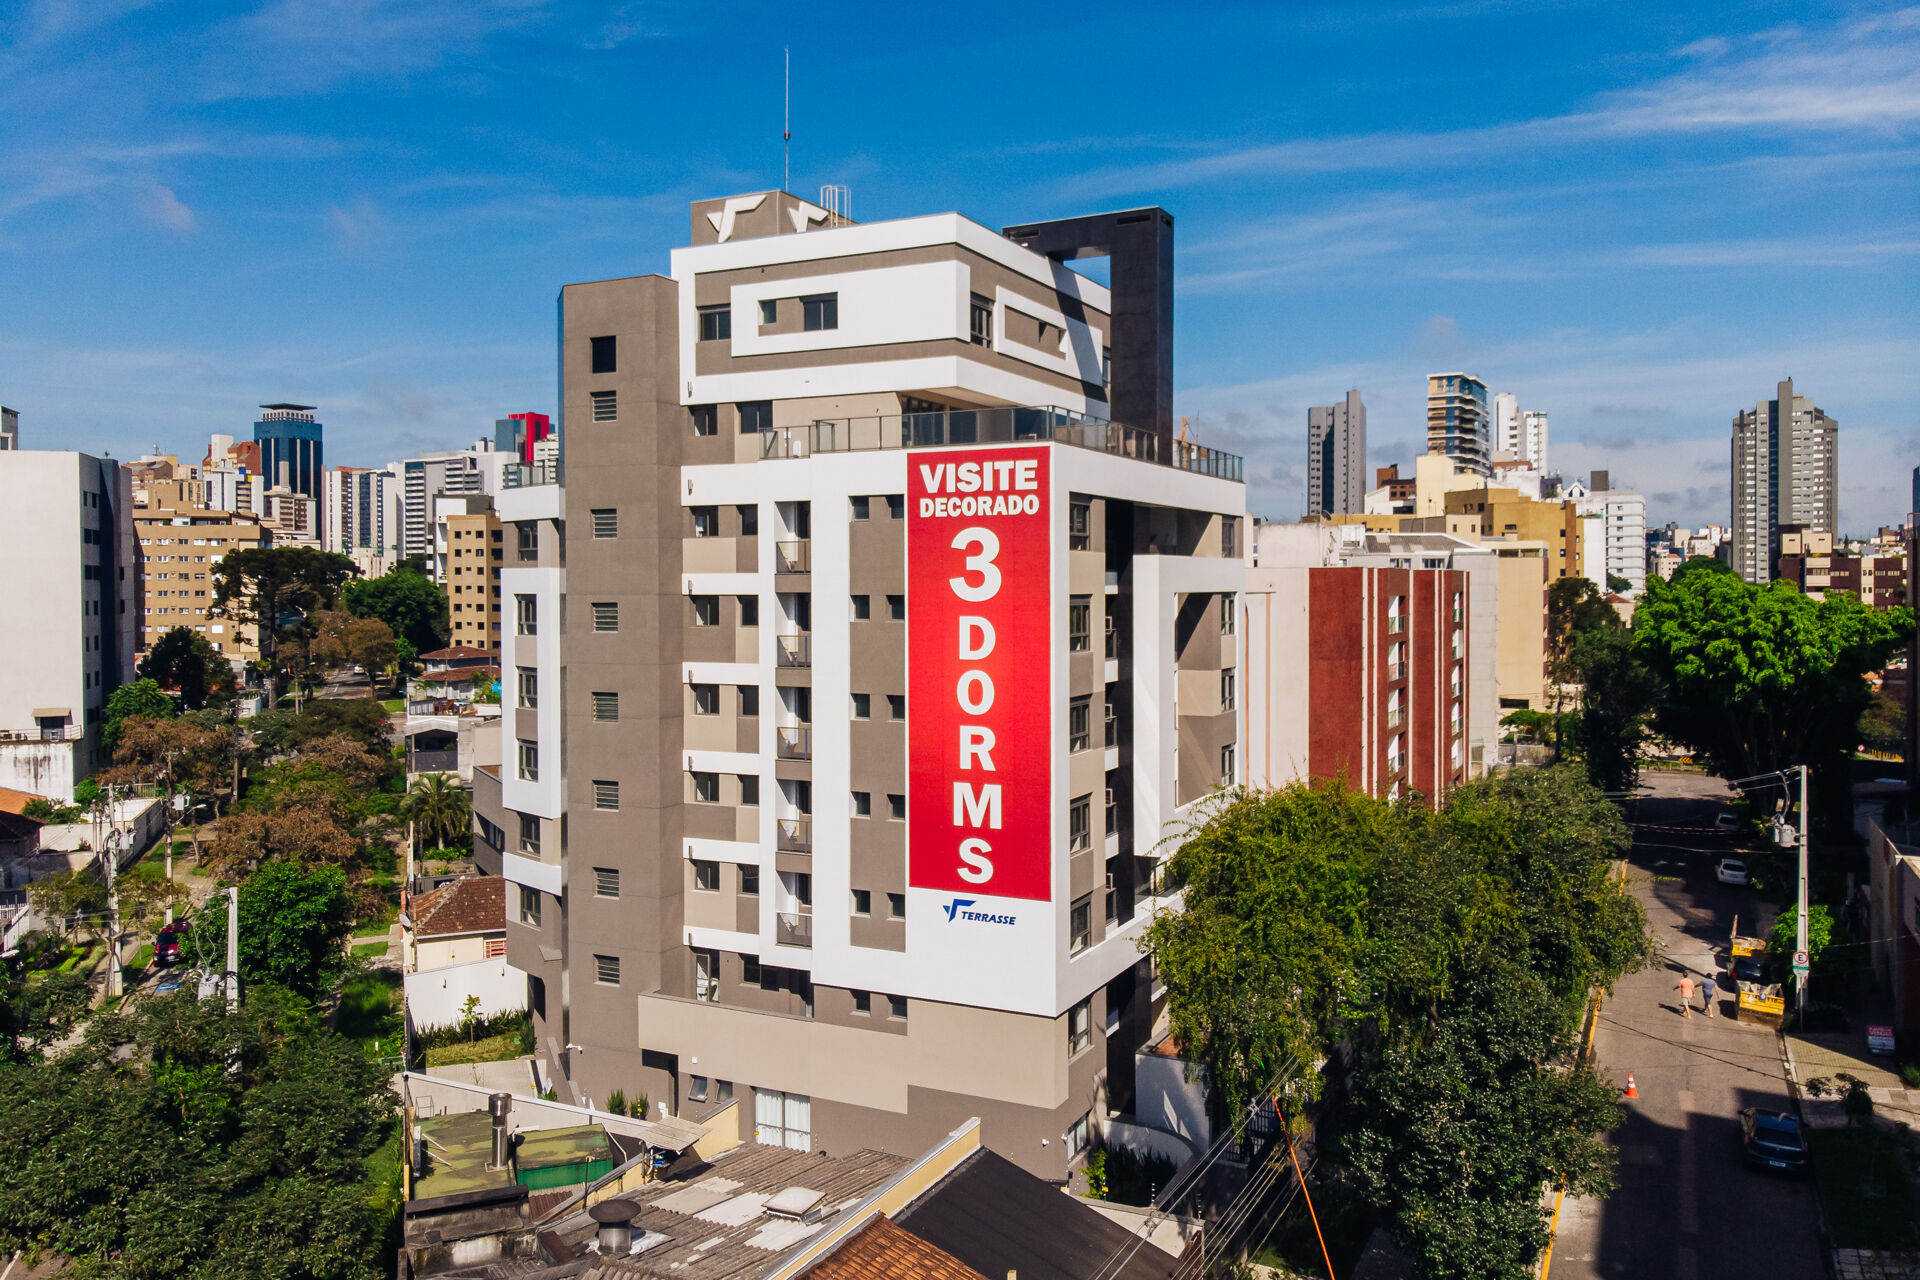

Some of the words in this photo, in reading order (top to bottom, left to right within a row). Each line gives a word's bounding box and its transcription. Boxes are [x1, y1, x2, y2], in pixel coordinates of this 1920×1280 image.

[919, 459, 1038, 494] VISITE
[919, 494, 1040, 518] DECORADO
[949, 526, 1002, 602] 3
[953, 615, 1002, 884] DORMS
[961, 911, 1017, 925] TERRASSE
